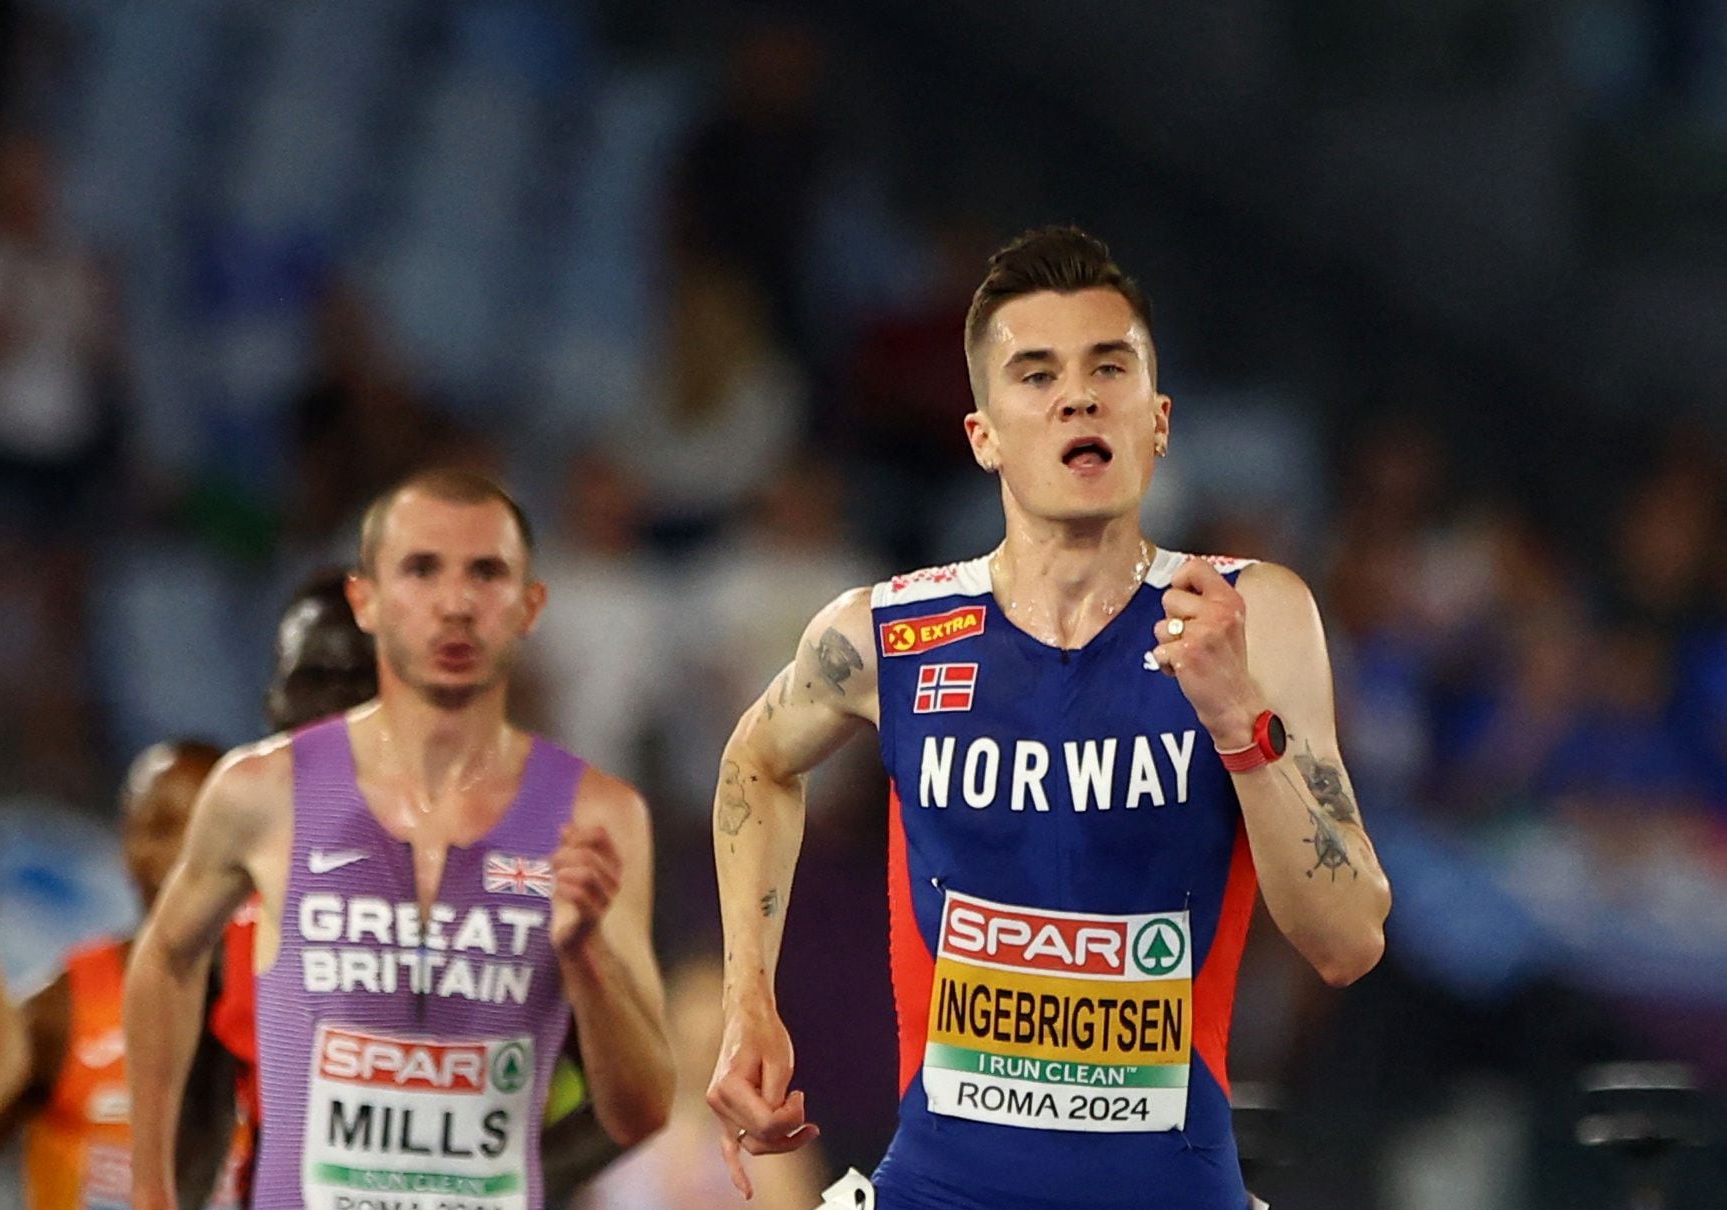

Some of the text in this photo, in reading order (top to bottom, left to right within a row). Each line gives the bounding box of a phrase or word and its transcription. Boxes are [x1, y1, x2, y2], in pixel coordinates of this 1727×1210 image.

[920, 614, 977, 642] EXTRA
[920, 730, 1196, 812] NORWAY
[299, 893, 545, 955] GREAT
[947, 907, 1121, 968] SPAR
[302, 948, 534, 1004] BRITAIN
[937, 977, 1183, 1053] INGEBRIGTSEN
[324, 1037, 483, 1087] SPAR
[990, 1055, 1040, 1080] RUN
[328, 1100, 510, 1158] MILLS
[957, 1082, 1150, 1121] ROMA 2024
